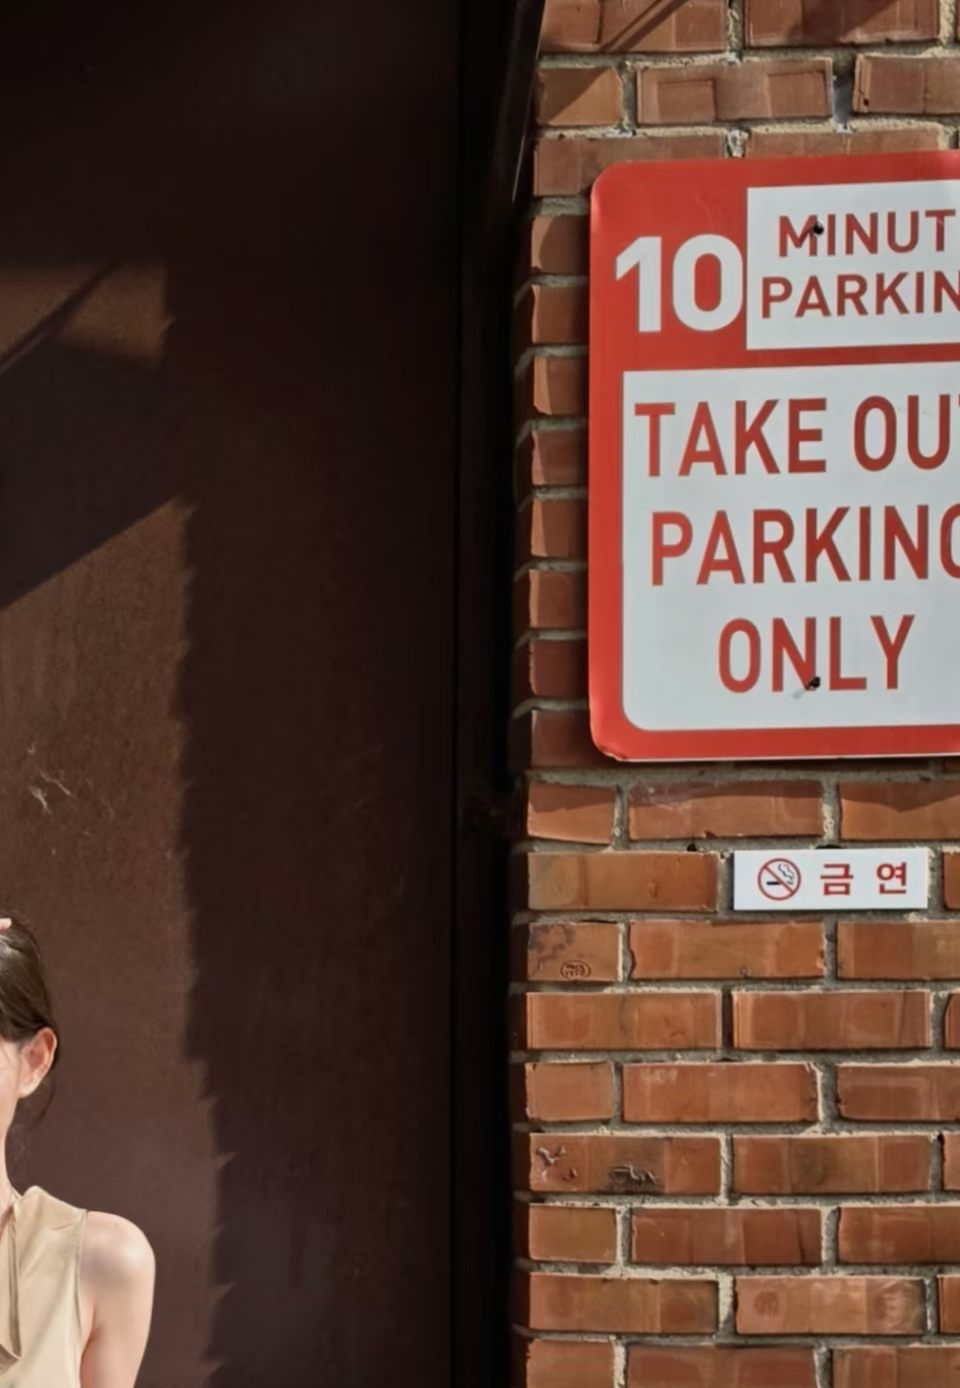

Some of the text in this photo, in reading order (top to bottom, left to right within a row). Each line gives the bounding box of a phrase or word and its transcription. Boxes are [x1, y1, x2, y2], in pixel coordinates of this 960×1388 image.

[778, 208, 957, 257] MINUT
[615, 234, 744, 333] 10
[761, 269, 960, 319] PARKIN
[634, 393, 960, 478] TAKE OU
[717, 614, 916, 693] ONLY
